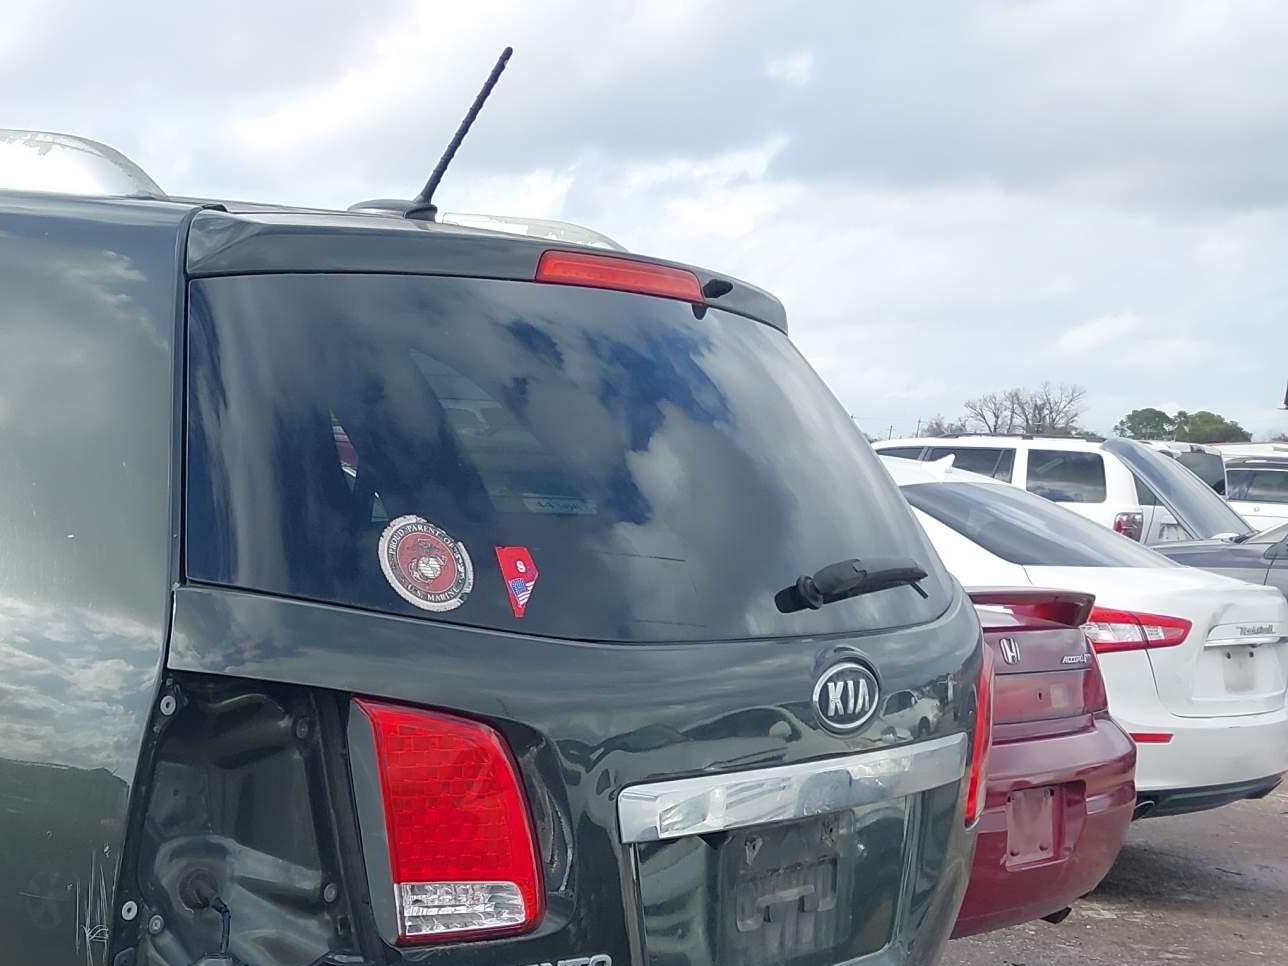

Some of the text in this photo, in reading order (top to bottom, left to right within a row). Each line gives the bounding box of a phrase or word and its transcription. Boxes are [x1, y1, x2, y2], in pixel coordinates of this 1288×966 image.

[389, 529, 404, 555] PROUD
[406, 524, 439, 537] PARENT
[827, 678, 870, 717] KIA
